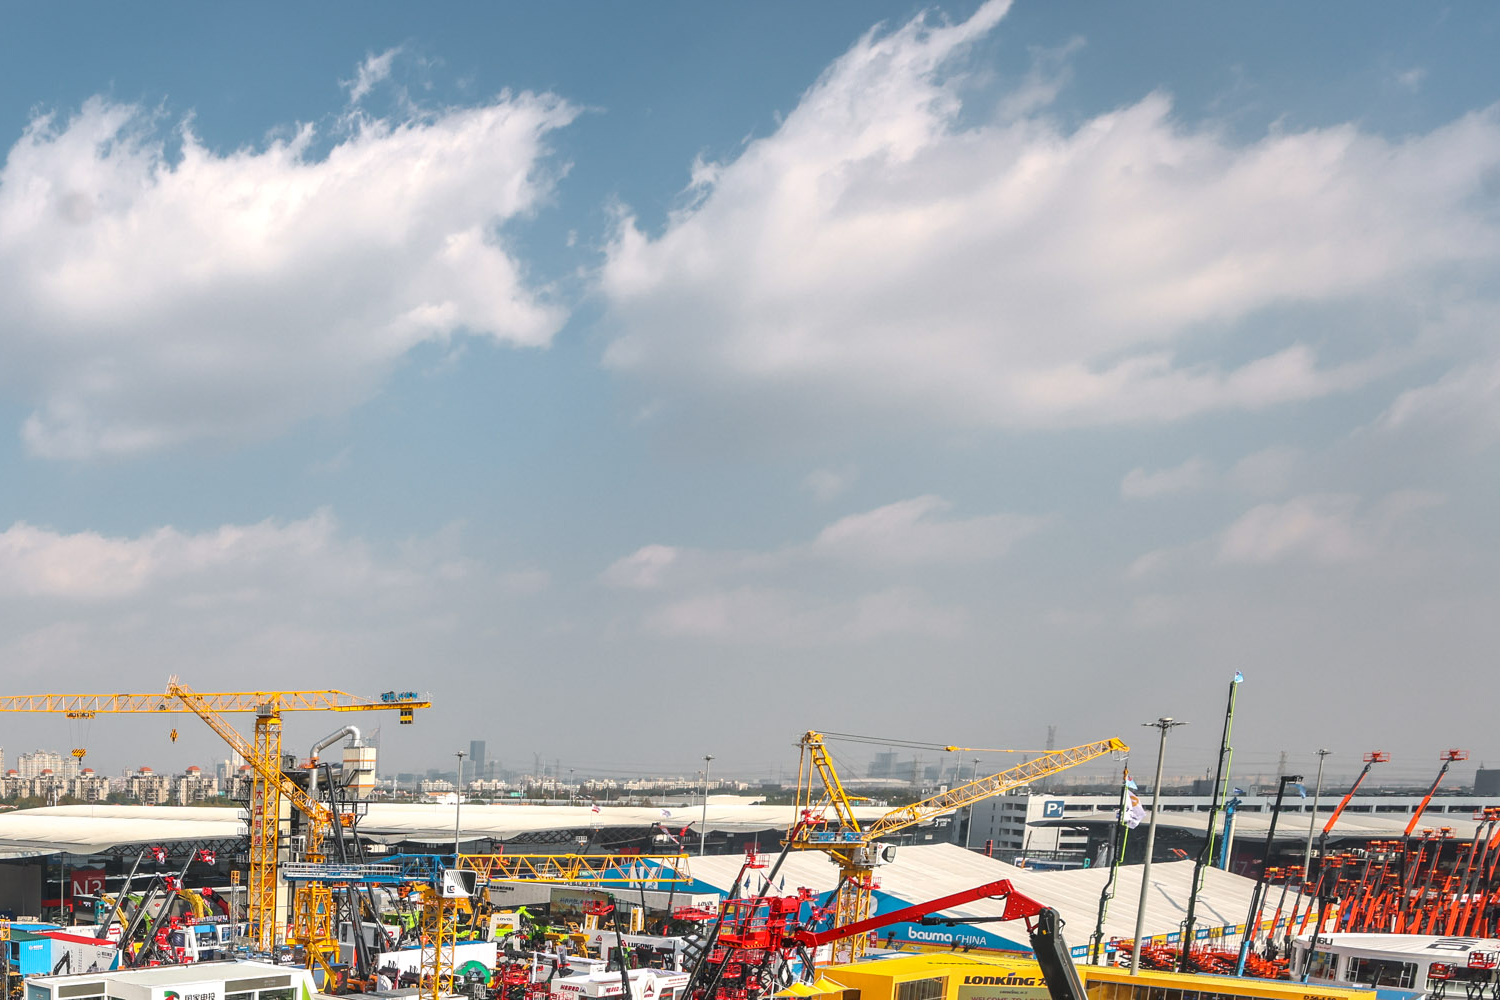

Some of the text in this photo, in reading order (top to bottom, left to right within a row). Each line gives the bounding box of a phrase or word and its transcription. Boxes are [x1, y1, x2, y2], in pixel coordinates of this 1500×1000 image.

[1046, 803, 1062, 815] P1
[908, 926, 987, 946] bauma CHINA
[963, 973, 1036, 986] LONKING
